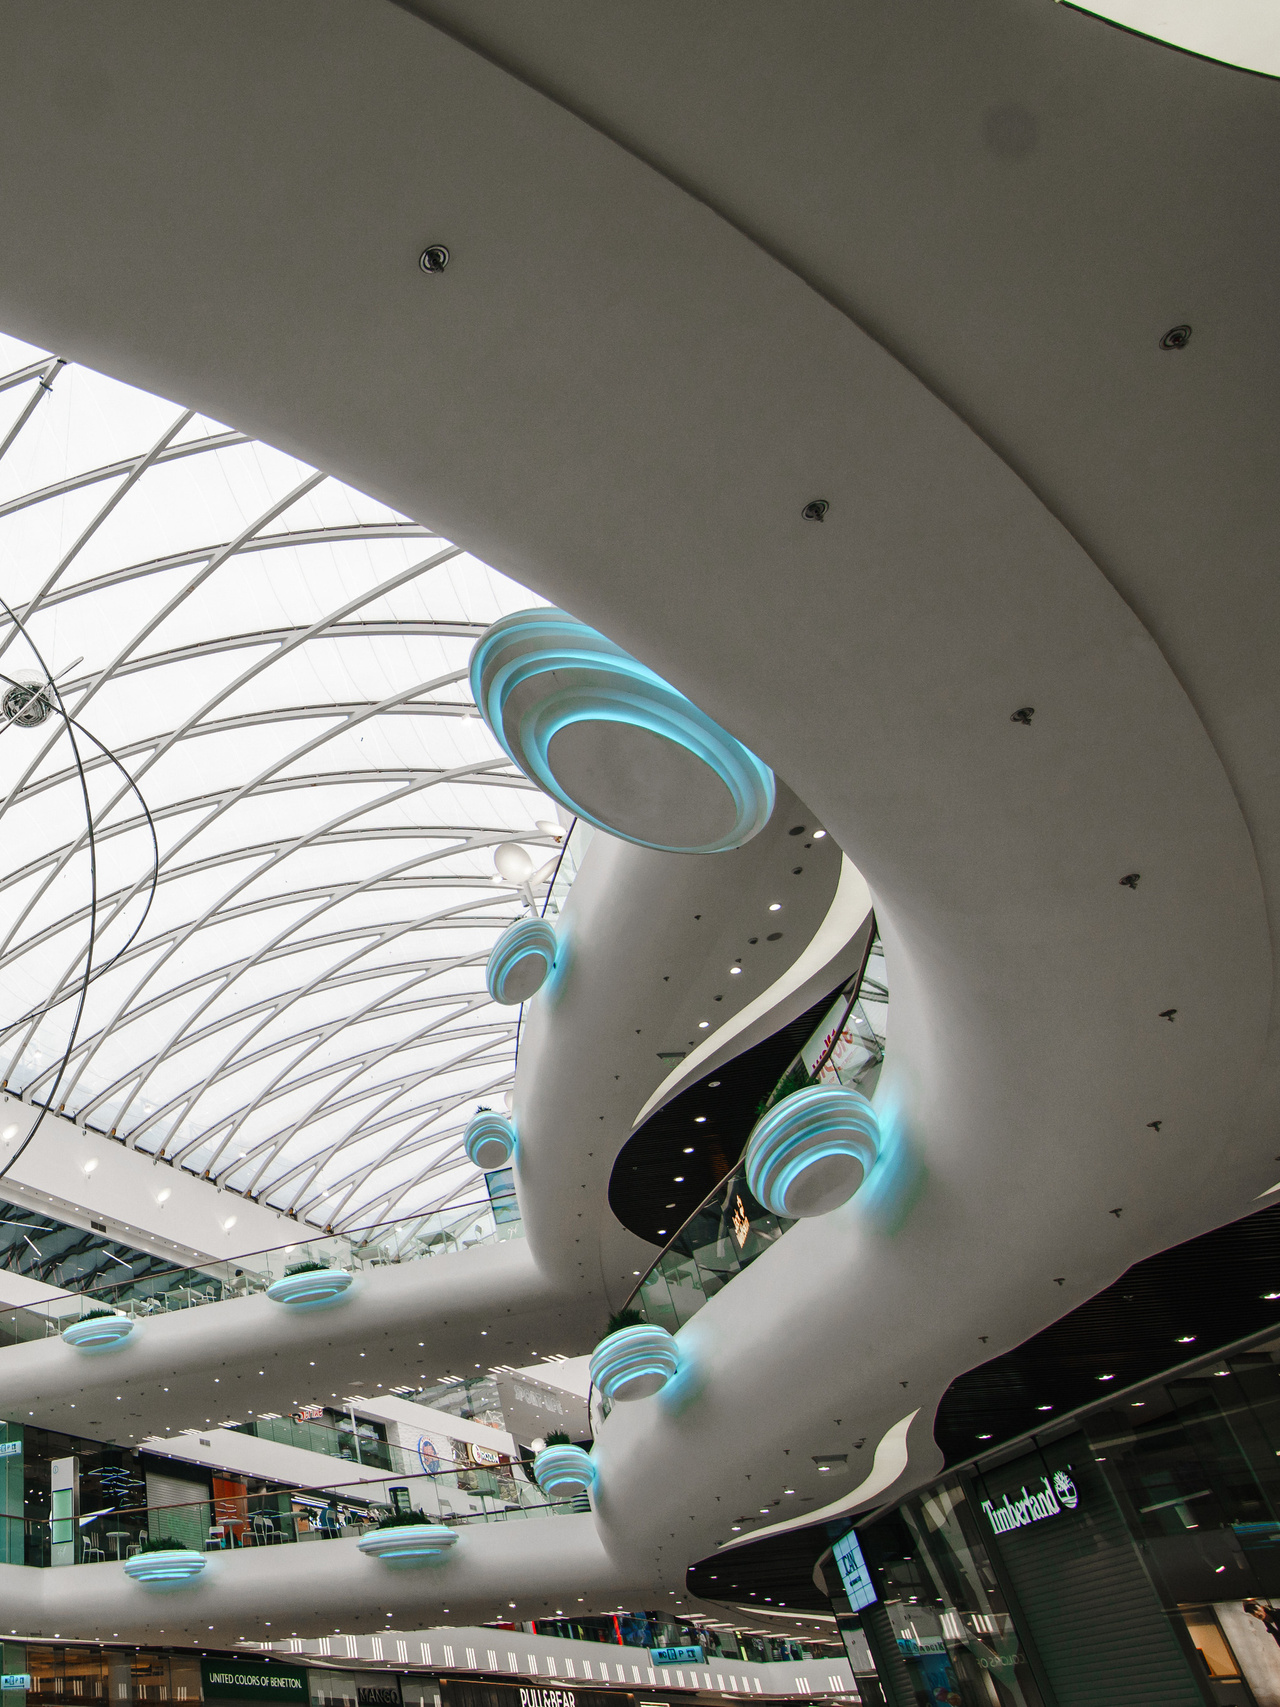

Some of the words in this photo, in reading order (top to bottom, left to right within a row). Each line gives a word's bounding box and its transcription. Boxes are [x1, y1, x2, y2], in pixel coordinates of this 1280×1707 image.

[982, 1476, 1060, 1535] Timberland
[678, 1650, 684, 1658] P
[209, 1672, 234, 1684] UNITED
[234, 1674, 261, 1687] COLORS
[260, 1676, 270, 1687] OF
[357, 1687, 400, 1705] MANGO
[519, 1688, 576, 1707] PULL&BEAR
